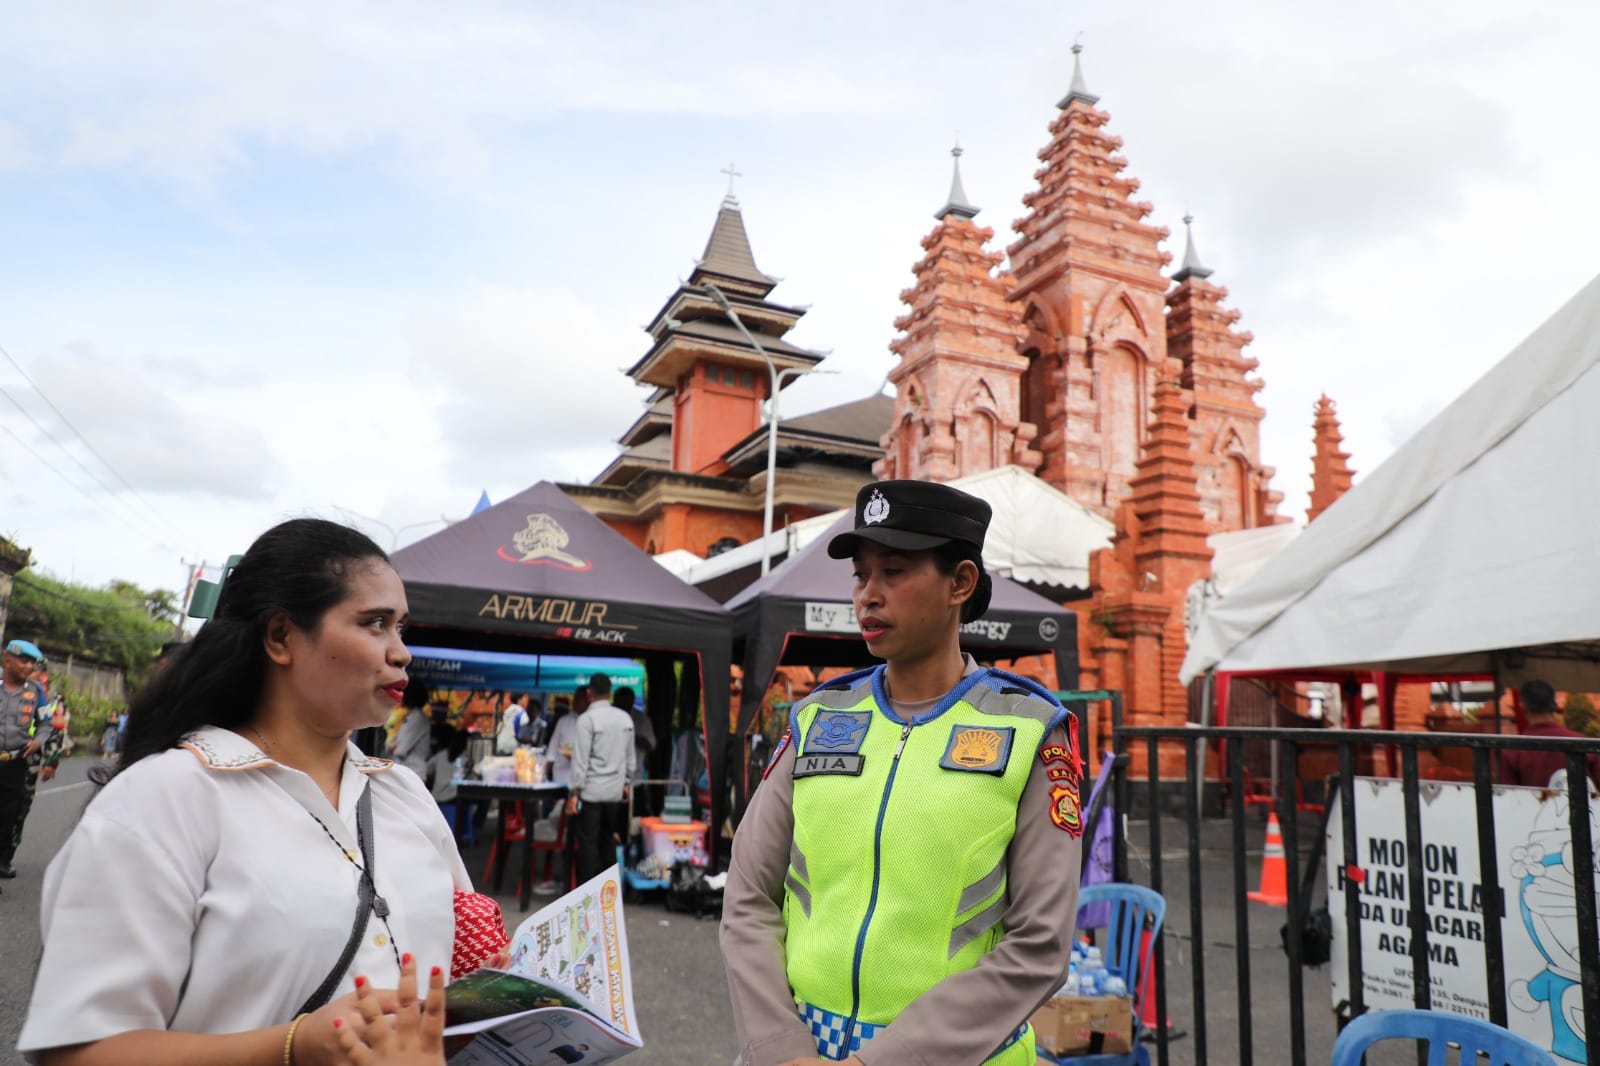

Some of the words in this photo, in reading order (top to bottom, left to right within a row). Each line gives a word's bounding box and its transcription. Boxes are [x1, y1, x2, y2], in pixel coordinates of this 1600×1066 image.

[478, 594, 608, 626] ARMOUR
[811, 605, 837, 627] My
[959, 619, 1012, 640] nergy
[806, 757, 847, 770] NIA
[1369, 837, 1458, 875] MOON
[1337, 865, 1405, 901] PLAN
[1360, 902, 1385, 924] DA
[1391, 906, 1484, 942] UACAR
[1378, 932, 1459, 968] AGMA
